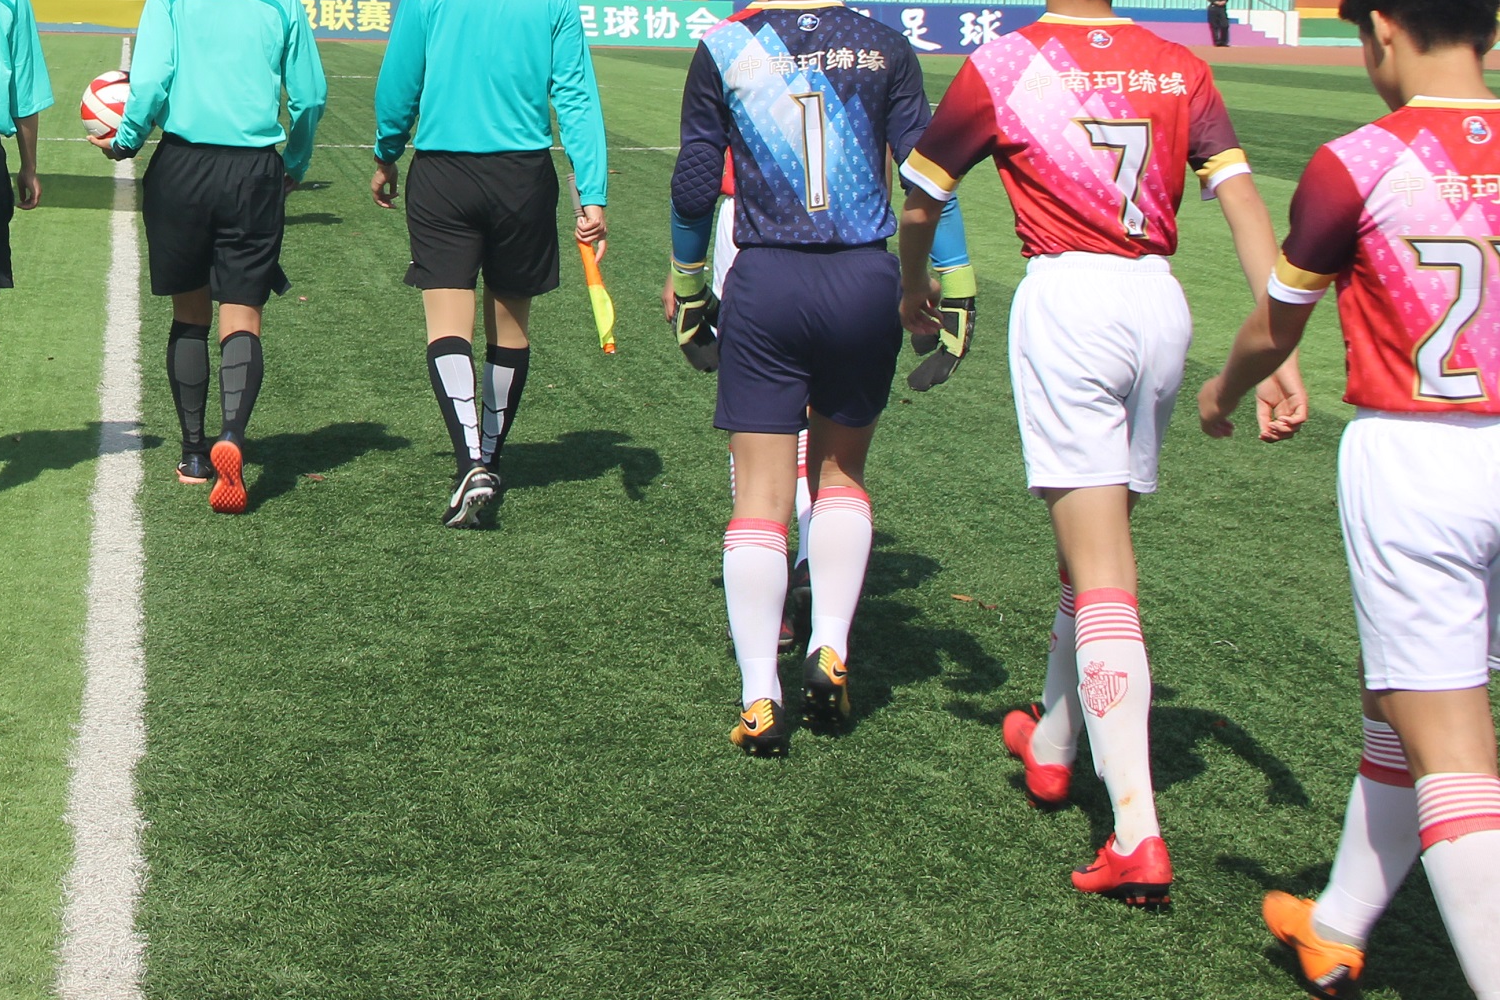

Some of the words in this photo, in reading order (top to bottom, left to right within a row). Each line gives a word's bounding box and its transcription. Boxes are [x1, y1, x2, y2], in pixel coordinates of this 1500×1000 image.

[579, 5, 722, 40] 足球协会
[739, 47, 887, 80] 中南珂缔缘
[1024, 66, 1188, 101] 中南珂缔缘
[790, 91, 830, 213] 1
[1070, 117, 1152, 241] 7
[1397, 235, 1500, 404] 2
